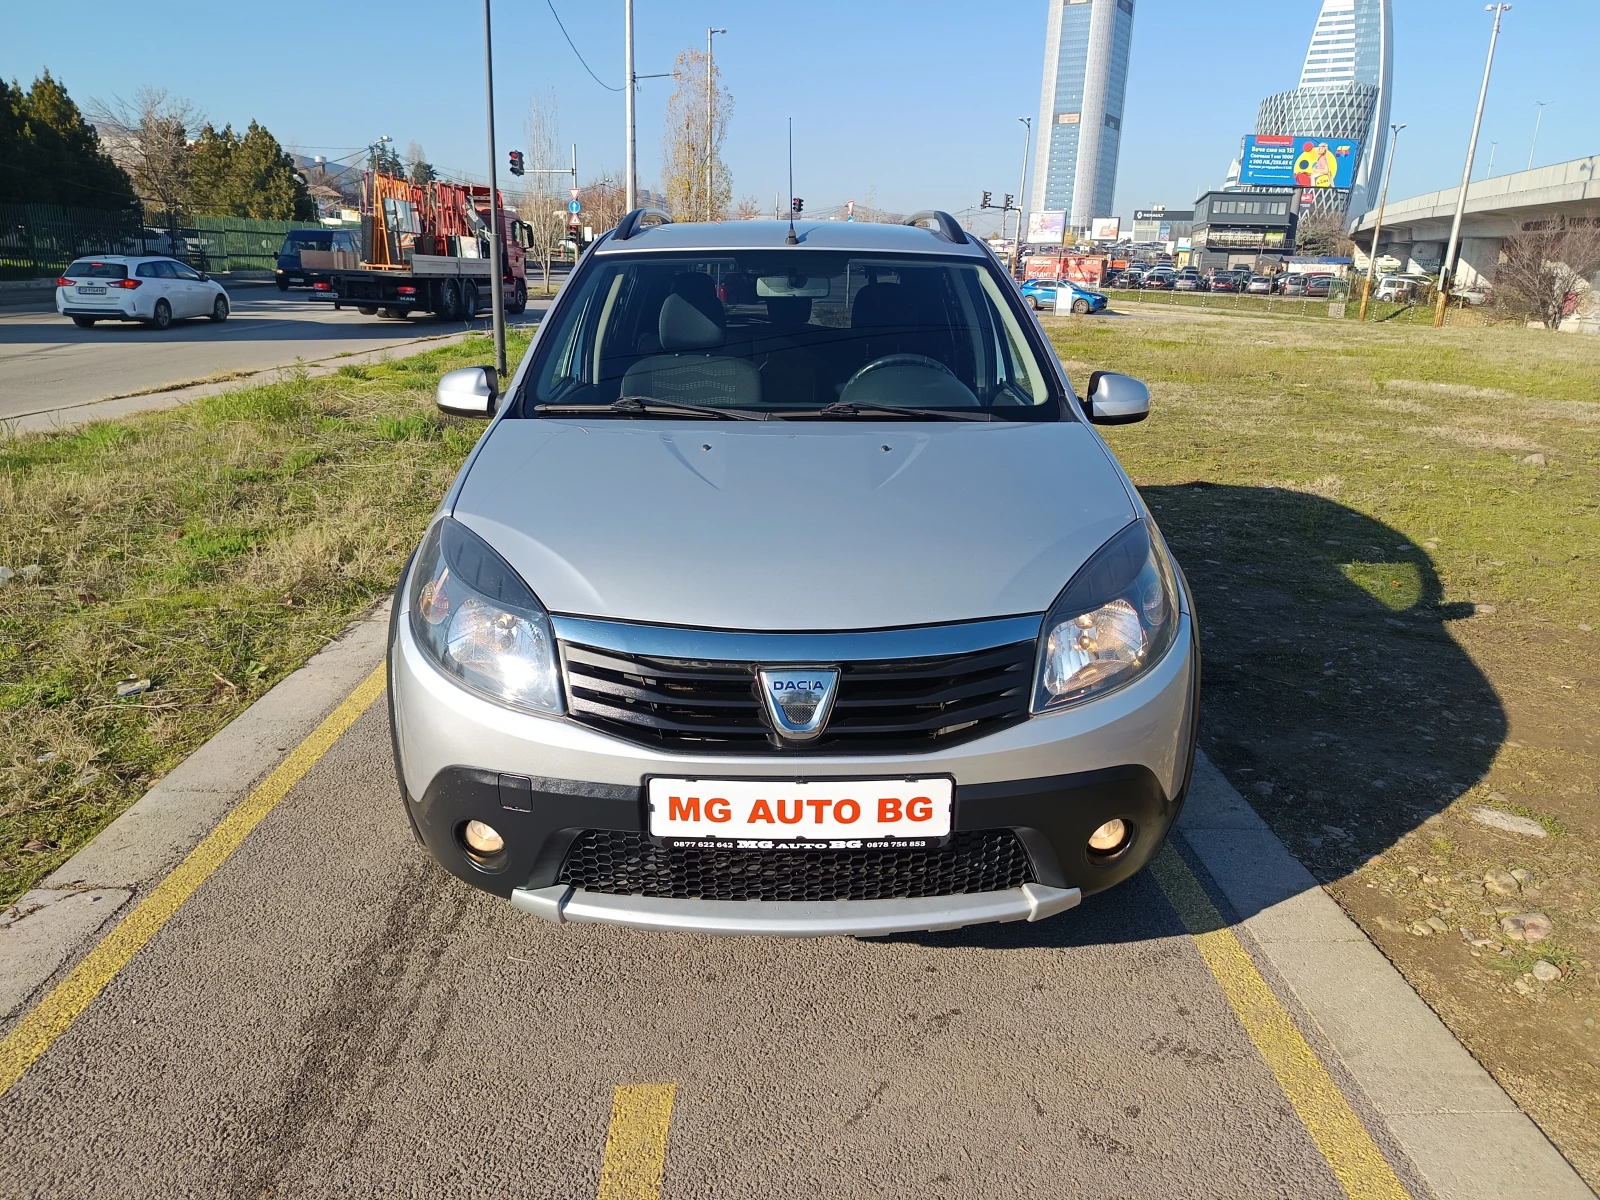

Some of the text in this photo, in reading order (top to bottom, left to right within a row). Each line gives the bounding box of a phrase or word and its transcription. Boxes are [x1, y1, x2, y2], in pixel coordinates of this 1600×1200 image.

[773, 680, 824, 691] DACIA
[668, 796, 933, 825] MG AUTO BG
[736, 840, 775, 849] MG
[775, 842, 828, 850] AUTO
[828, 840, 863, 849] BG
